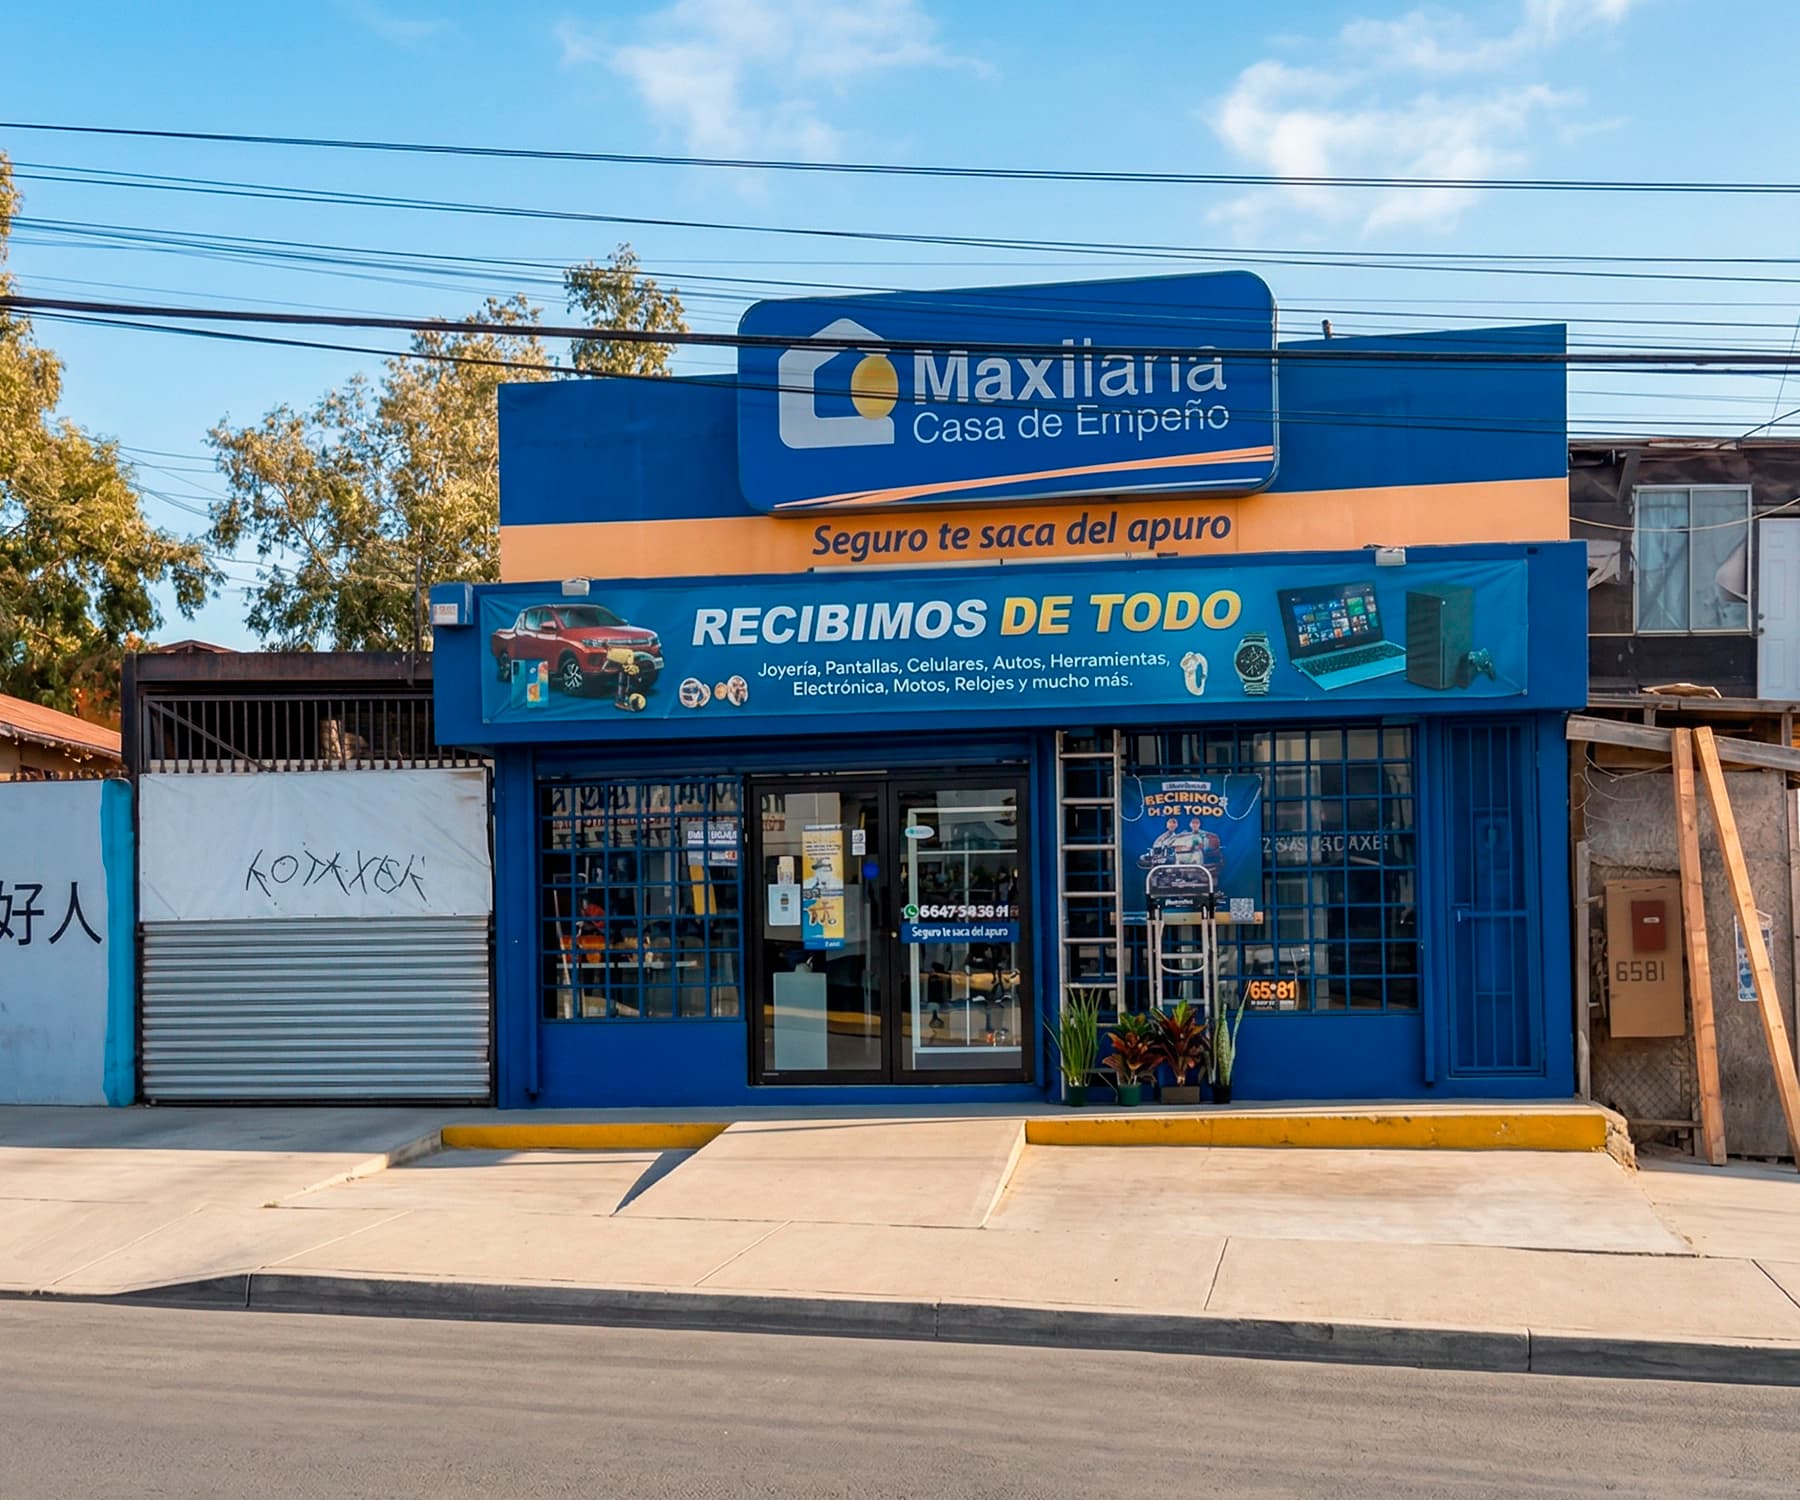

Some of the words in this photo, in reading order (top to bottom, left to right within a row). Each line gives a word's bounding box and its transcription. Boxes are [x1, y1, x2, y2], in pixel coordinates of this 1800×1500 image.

[913, 412, 1006, 443] Casa
[1018, 408, 1062, 438] de
[1077, 398, 1230, 441] Empeño
[812, 525, 928, 562] Seguro
[938, 522, 970, 549] te
[980, 522, 1055, 548] saca
[1066, 512, 1117, 545] del
[1127, 514, 1232, 549] apuro
[691, 598, 988, 647] RECIBIMOS
[1000, 595, 1074, 636] DE
[1090, 589, 1243, 633] TODO
[758, 660, 821, 680] Joyería,
[825, 658, 903, 676] Pantallas,
[907, 656, 988, 673] Celulares,
[993, 655, 1046, 671] Autos,
[1050, 650, 1170, 668] Herramientas,
[793, 678, 889, 697] Electrónica,
[893, 677, 950, 694] Motos,
[955, 674, 1014, 694] Relojes
[1018, 677, 1028, 693] y
[1032, 673, 1090, 689] mucho
[1094, 671, 1133, 688] más.
[1184, 805, 1224, 817] TODO
[1616, 960, 1665, 982] 6581
